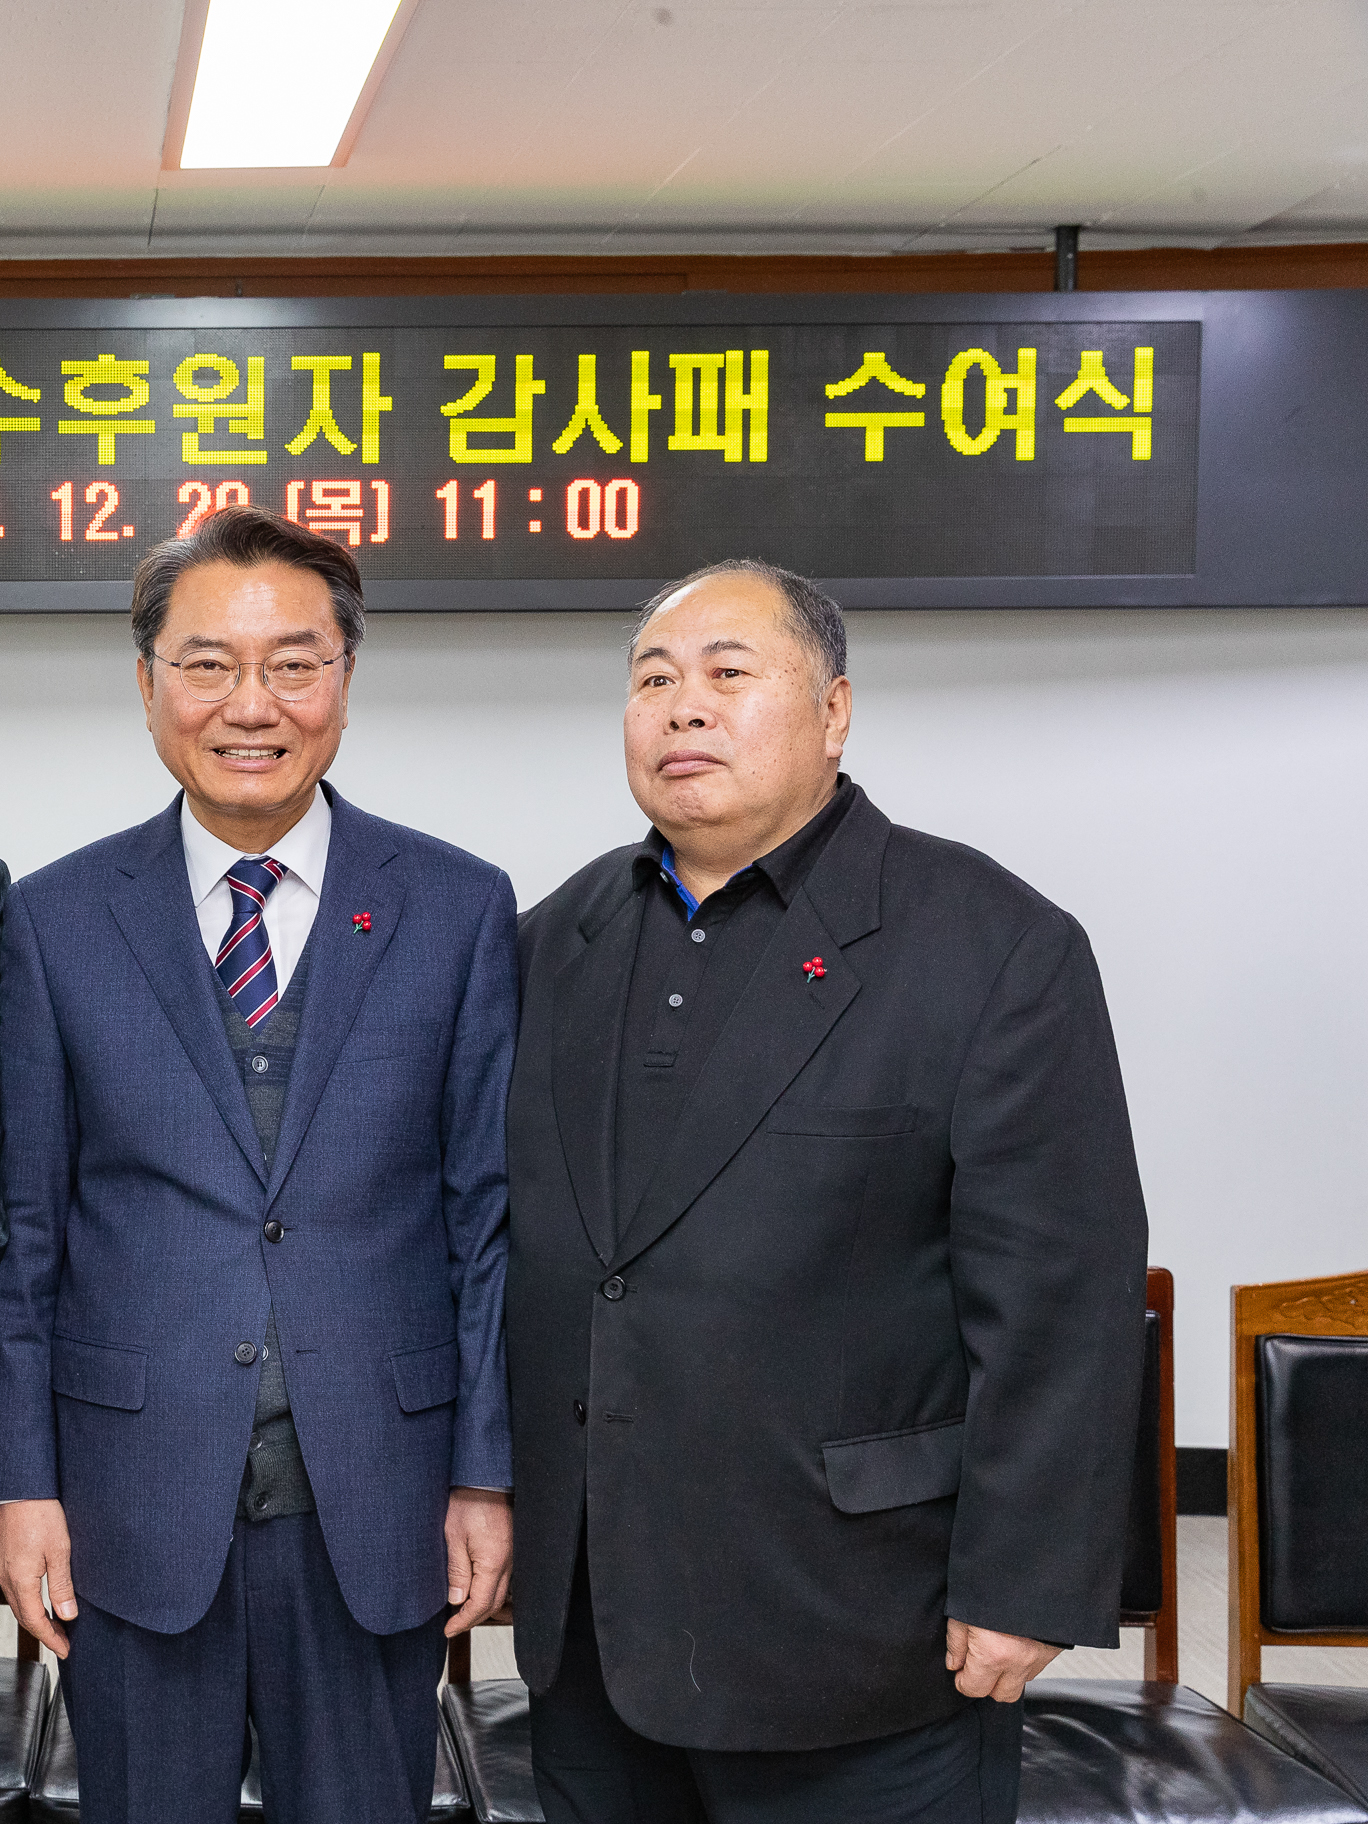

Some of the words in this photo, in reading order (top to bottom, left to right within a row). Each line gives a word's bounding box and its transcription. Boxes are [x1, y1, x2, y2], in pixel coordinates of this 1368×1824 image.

[440, 349, 769, 464] 감사패
[824, 346, 1154, 462] 수여식
[49, 480, 136, 543] 12.
